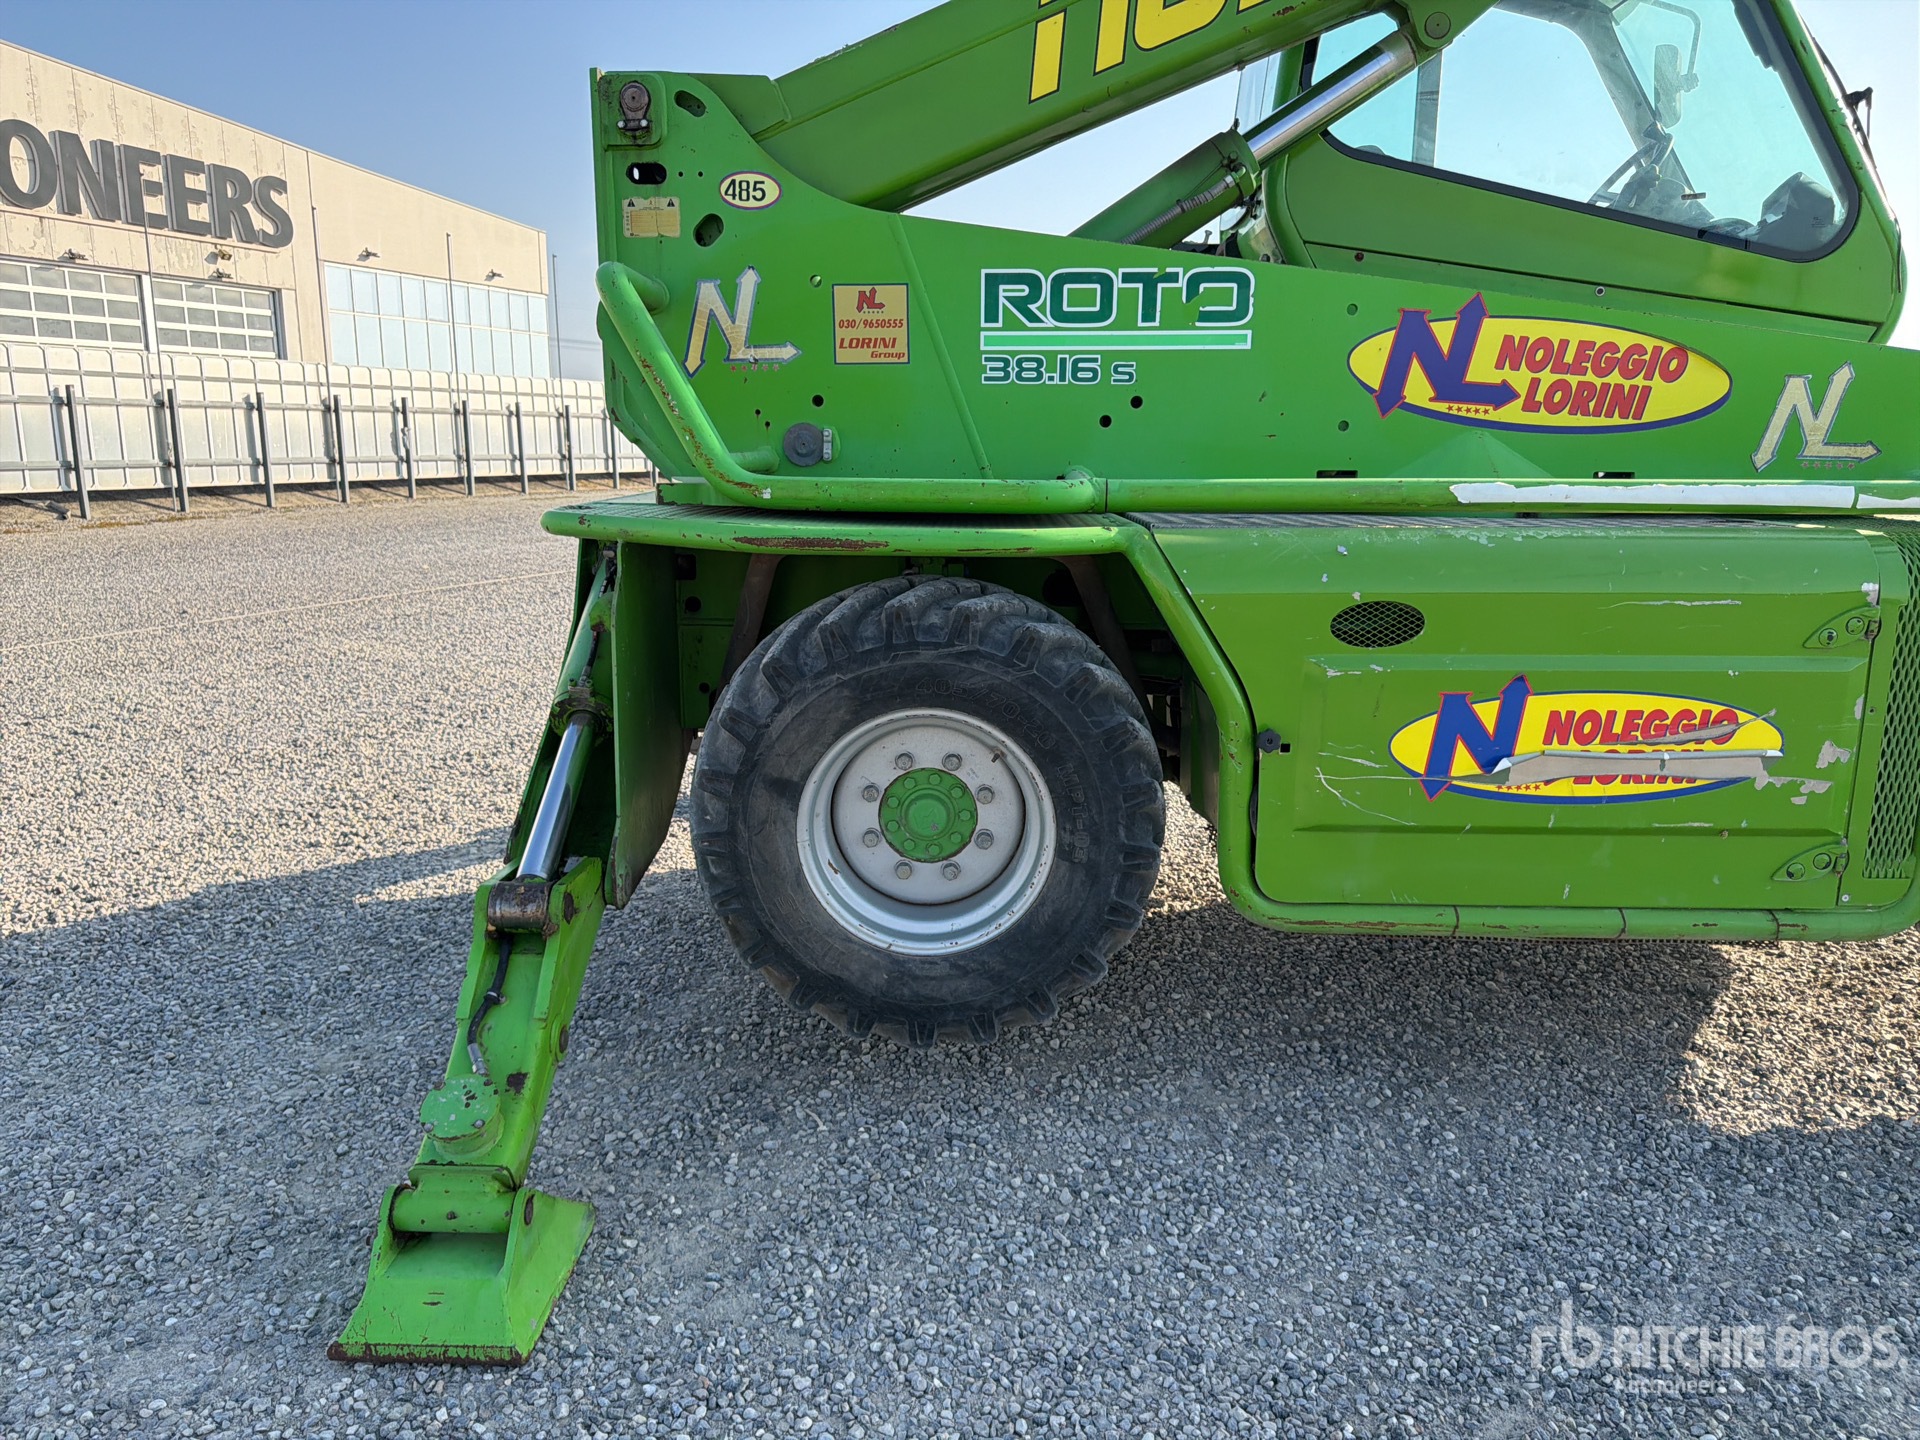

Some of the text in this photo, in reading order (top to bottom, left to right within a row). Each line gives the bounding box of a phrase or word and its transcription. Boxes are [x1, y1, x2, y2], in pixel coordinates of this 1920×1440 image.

[724, 179, 767, 202] 485
[980, 267, 1255, 328] ROTO
[838, 318, 904, 330] 030/9650555
[838, 337, 897, 349] LORINI
[870, 350, 906, 360] Group
[981, 354, 1101, 385] 38.16
[1495, 334, 1690, 383] NOLEGGIO
[1519, 378, 1653, 421] LORINI
